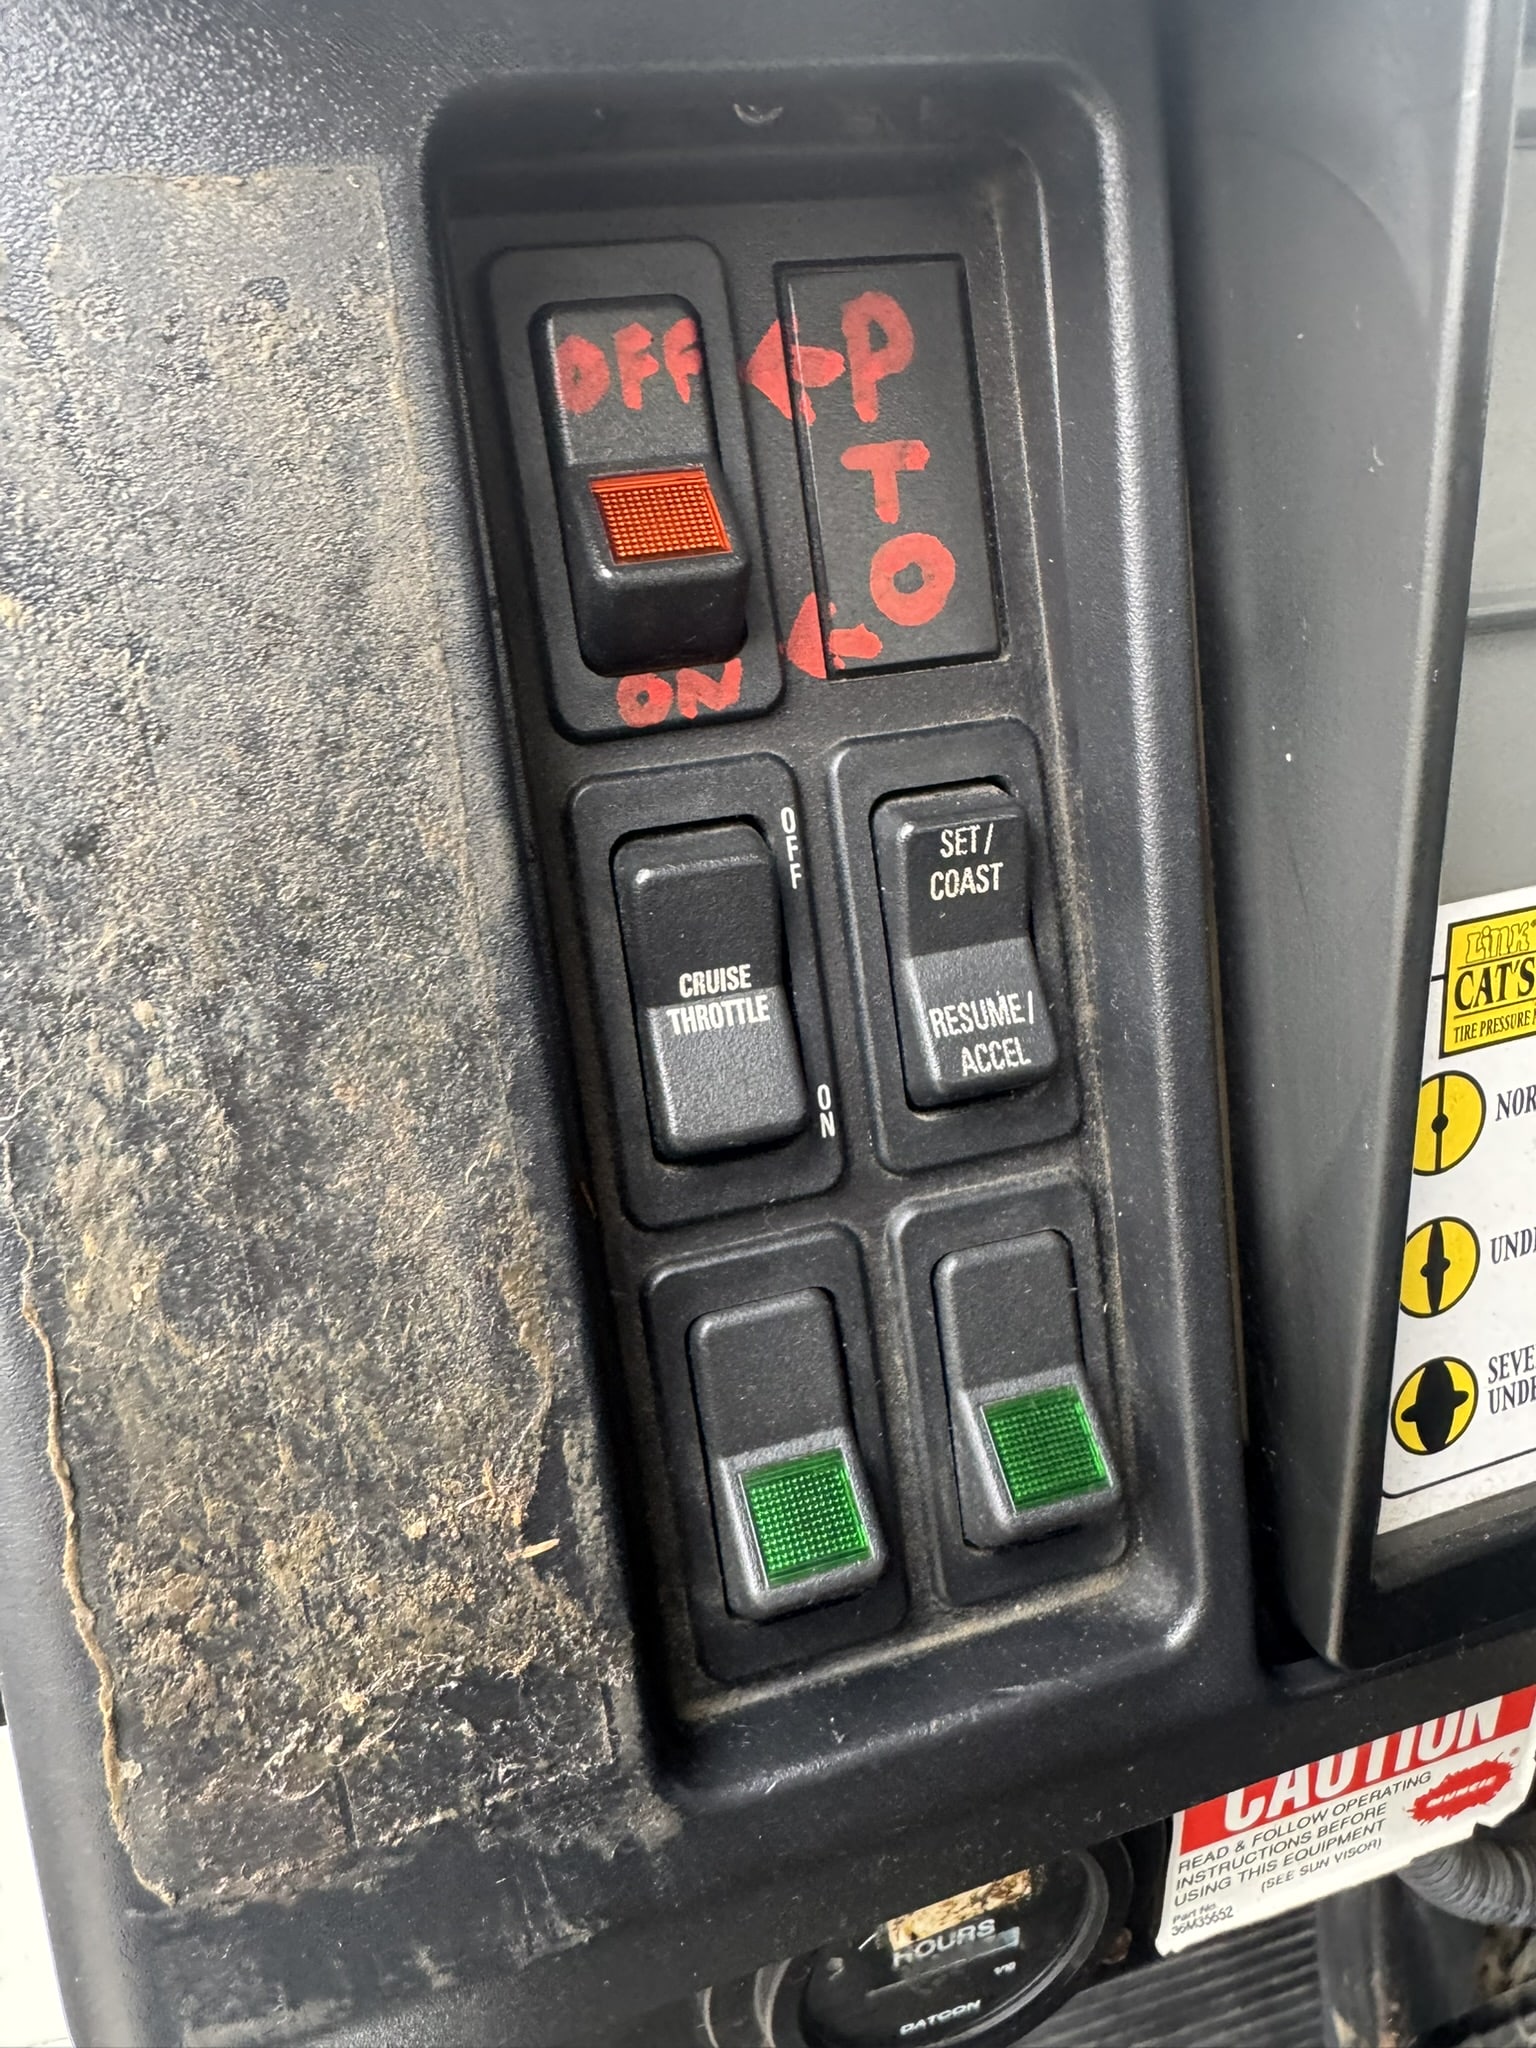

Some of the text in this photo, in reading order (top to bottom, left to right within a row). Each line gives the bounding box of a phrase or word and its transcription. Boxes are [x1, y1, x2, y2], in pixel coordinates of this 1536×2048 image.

[555, 316, 701, 414] OFF
[616, 657, 743, 728] ON
[780, 806, 802, 890] OFF
[930, 862, 1004, 900] COAST
[1465, 921, 1529, 963] Link
[679, 964, 752, 998] CRUISE
[1454, 956, 1535, 1011] CAT'S
[666, 994, 771, 1036] THROTTLE
[1453, 1022, 1478, 1043] TIRE
[1479, 1009, 1532, 1037] PRESSURE
[961, 1037, 1032, 1077] ACCEL
[816, 1083, 836, 1139] ON
[1490, 1226, 1536, 1264] UND
[1224, 1695, 1504, 1832] CAUTION
[1175, 1802, 1388, 1891] INSTRUCTIONS BEFORE
[1178, 1771, 1432, 1874] READ & FOLLOW OPERATING
[1174, 1817, 1387, 1907] USING THIS EQUIPMENT
[1261, 1837, 1383, 1893] (SEE SUN VISOR)
[1173, 1909, 1197, 1924] Part
[893, 1918, 996, 1968] HOURS
[899, 1999, 981, 2035] DATCON
